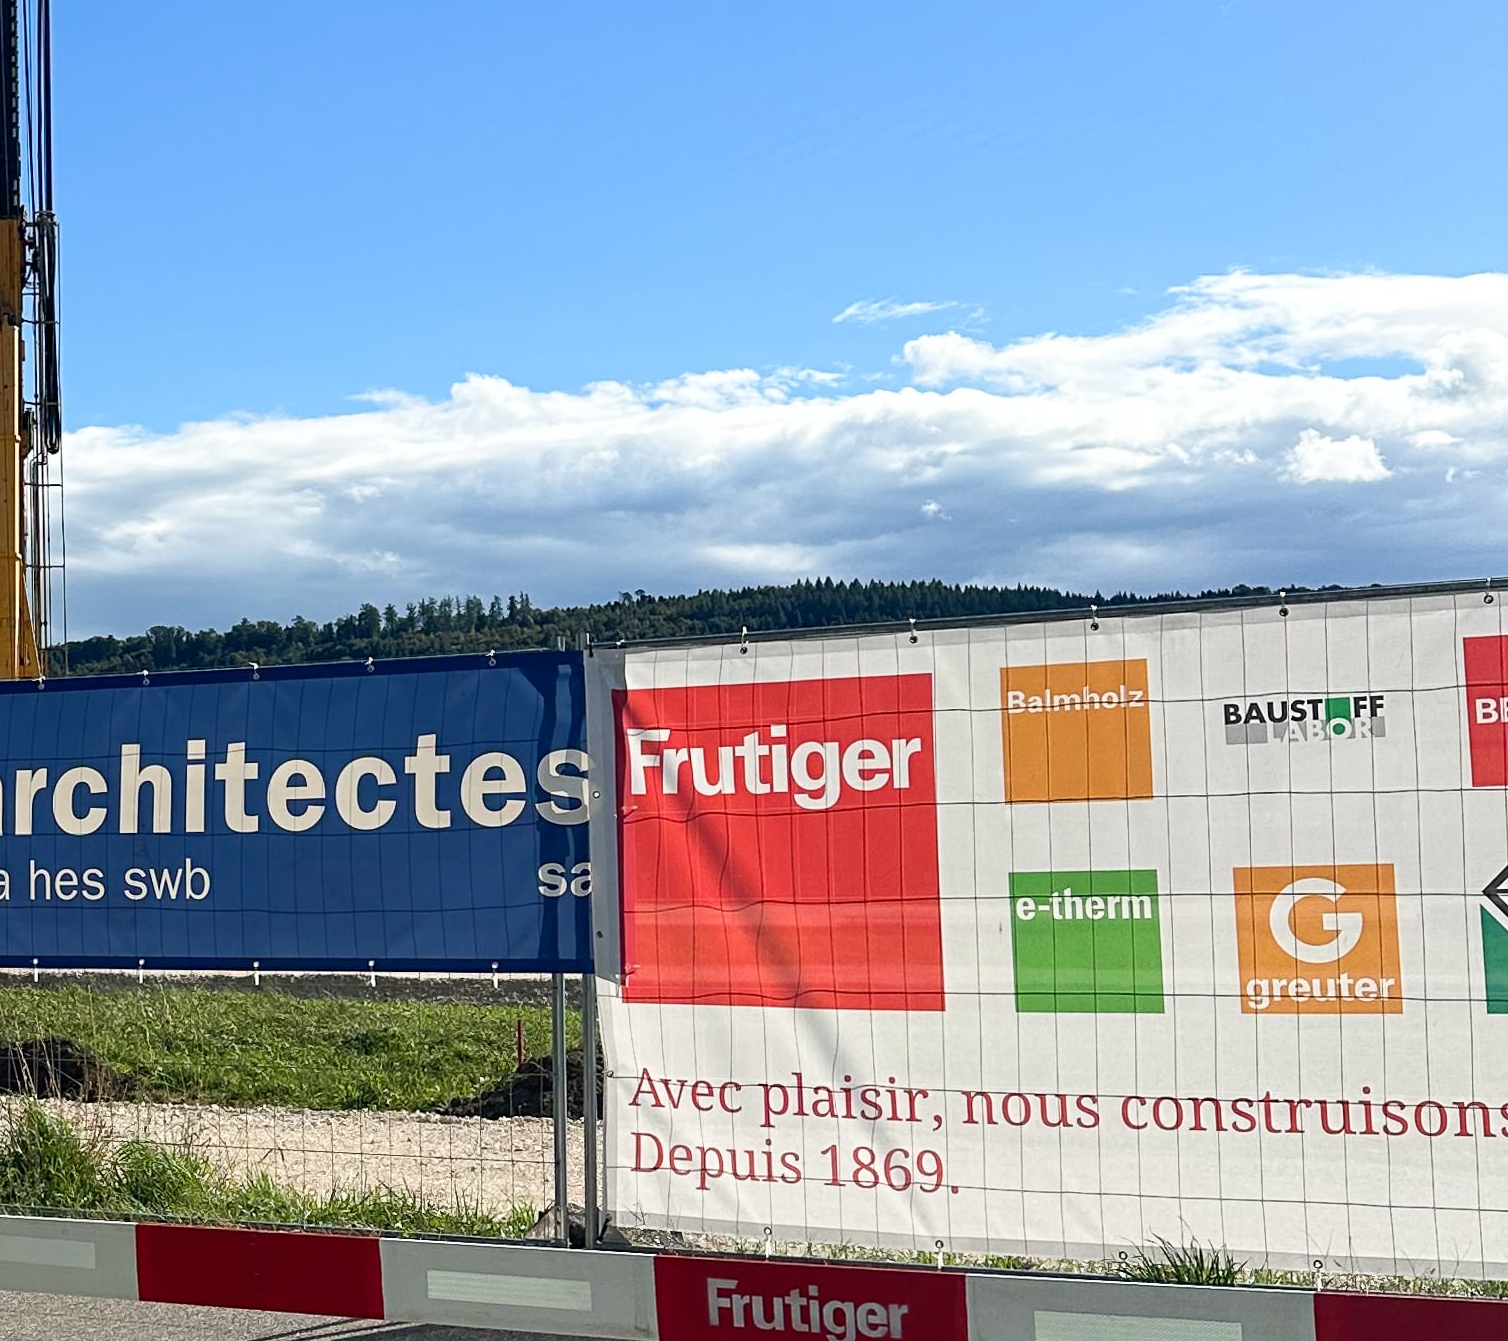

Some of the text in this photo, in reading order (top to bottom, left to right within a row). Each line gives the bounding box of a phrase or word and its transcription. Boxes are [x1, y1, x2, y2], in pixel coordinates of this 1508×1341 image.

[1006, 686, 1144, 715] Balmholz
[1224, 695, 1384, 725] BAUSTFF
[1267, 717, 1372, 742] LABOR
[628, 724, 920, 810] Frutiger
[30, 860, 105, 903] hes
[124, 858, 210, 903] swb
[538, 862, 592, 897] sa
[1016, 887, 1152, 922] e-therm
[1269, 877, 1362, 964] G
[1246, 971, 1395, 1010] greuter
[630, 1067, 742, 1114] Avec
[760, 1075, 943, 1130] plaisir,
[962, 1092, 1098, 1127] nous
[630, 1132, 960, 1195] Depuis 1869.
